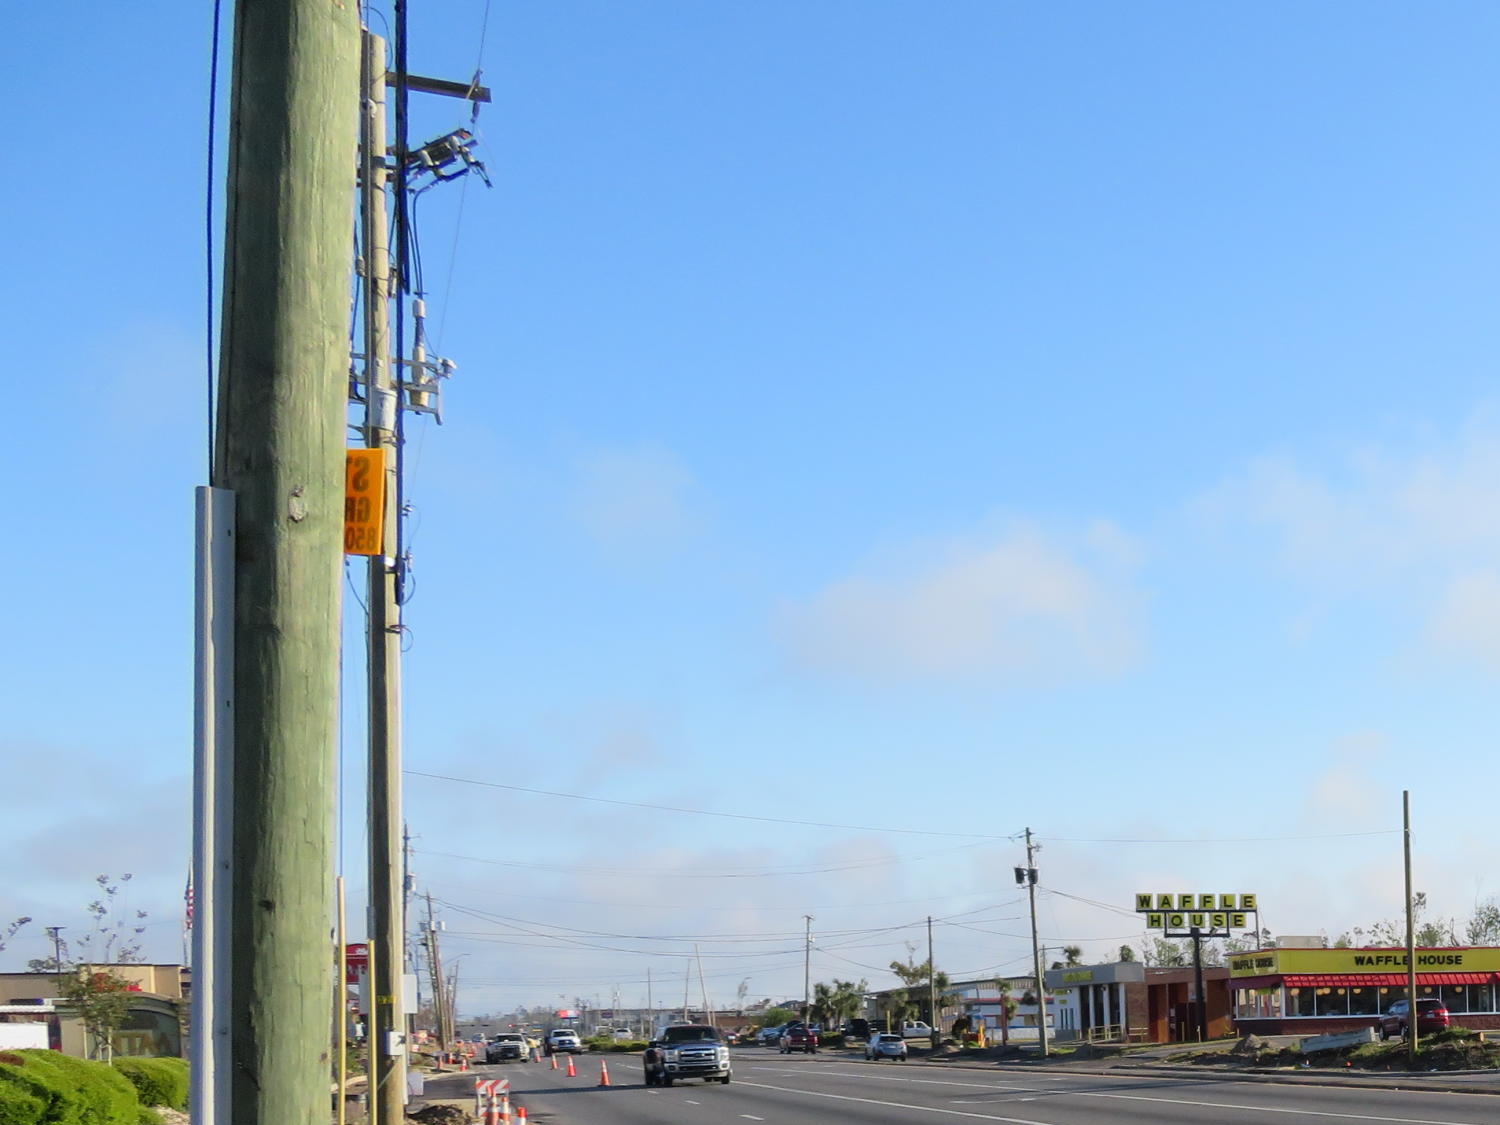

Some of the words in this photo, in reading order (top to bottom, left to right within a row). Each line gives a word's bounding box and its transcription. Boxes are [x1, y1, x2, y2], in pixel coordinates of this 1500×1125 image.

[1139, 895, 1254, 908] WAFFLE
[1150, 914, 1244, 927] HOUSE
[1354, 955, 1409, 966] WAFFLE
[1417, 955, 1463, 965] HOUSE
